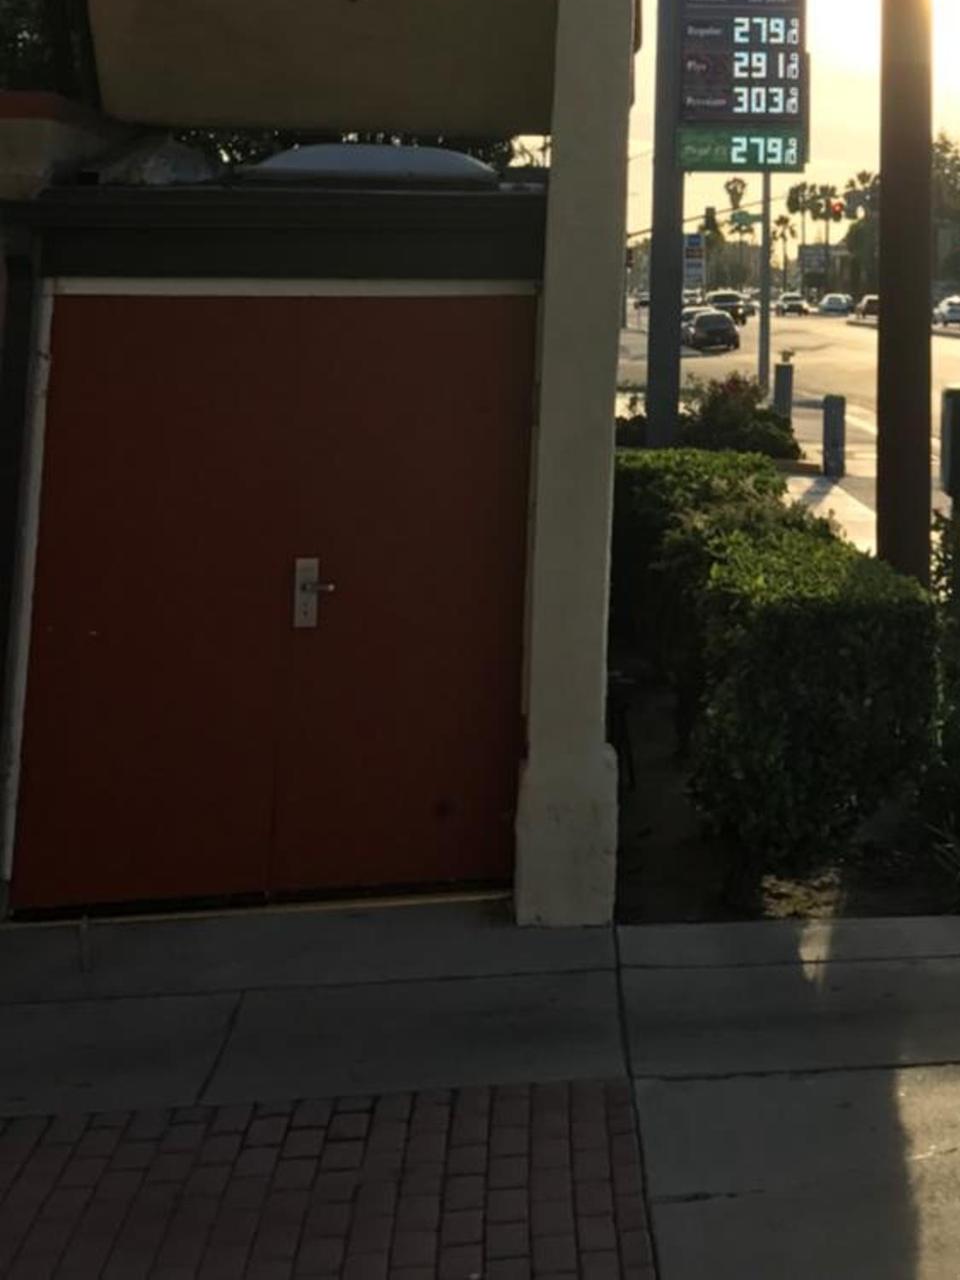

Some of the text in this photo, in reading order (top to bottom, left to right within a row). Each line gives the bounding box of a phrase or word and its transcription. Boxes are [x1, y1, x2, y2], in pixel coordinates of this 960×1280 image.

[733, 17, 785, 44] 279
[733, 52, 785, 79] 291
[733, 86, 785, 114] 303
[731, 136, 783, 164] 279
